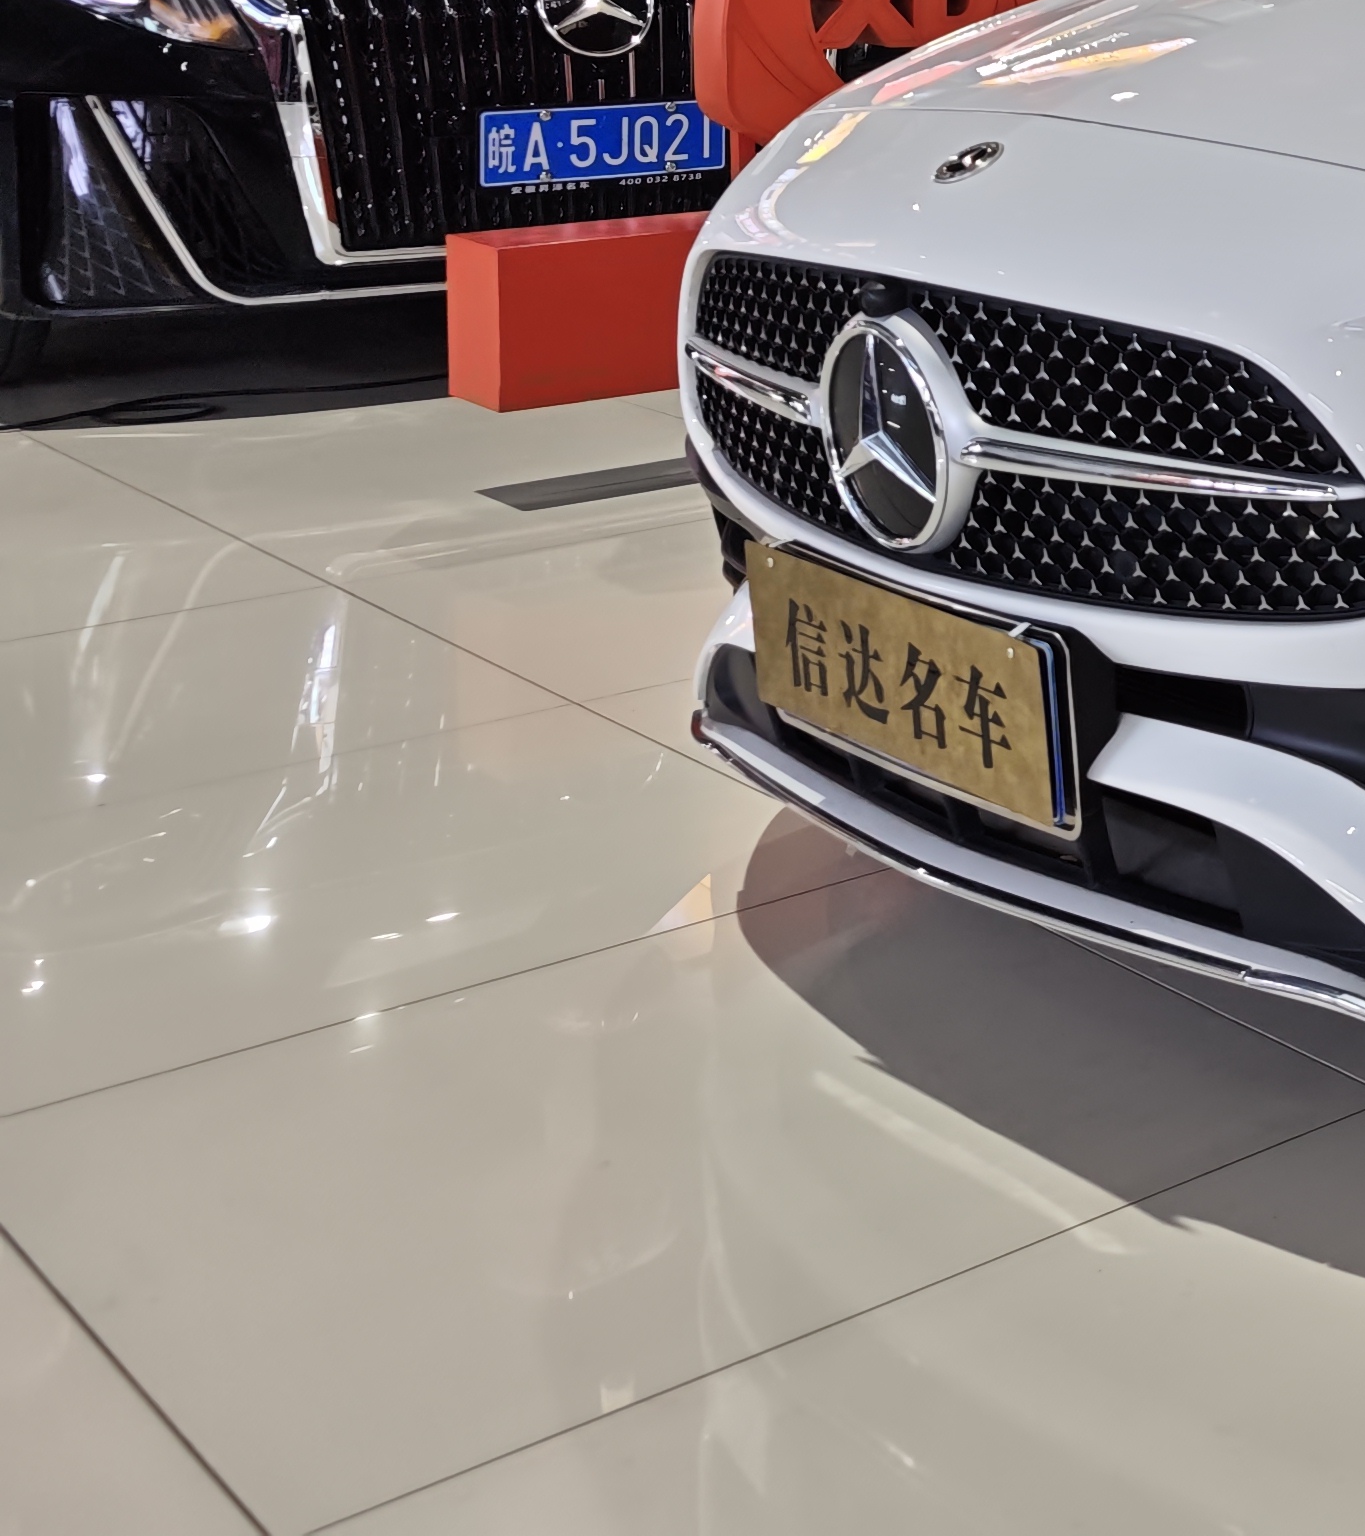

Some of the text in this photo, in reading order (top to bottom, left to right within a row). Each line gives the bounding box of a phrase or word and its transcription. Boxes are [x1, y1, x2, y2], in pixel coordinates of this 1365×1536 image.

[619, 173, 702, 186] 400 032 8738
[785, 598, 1012, 768] 信达名车
